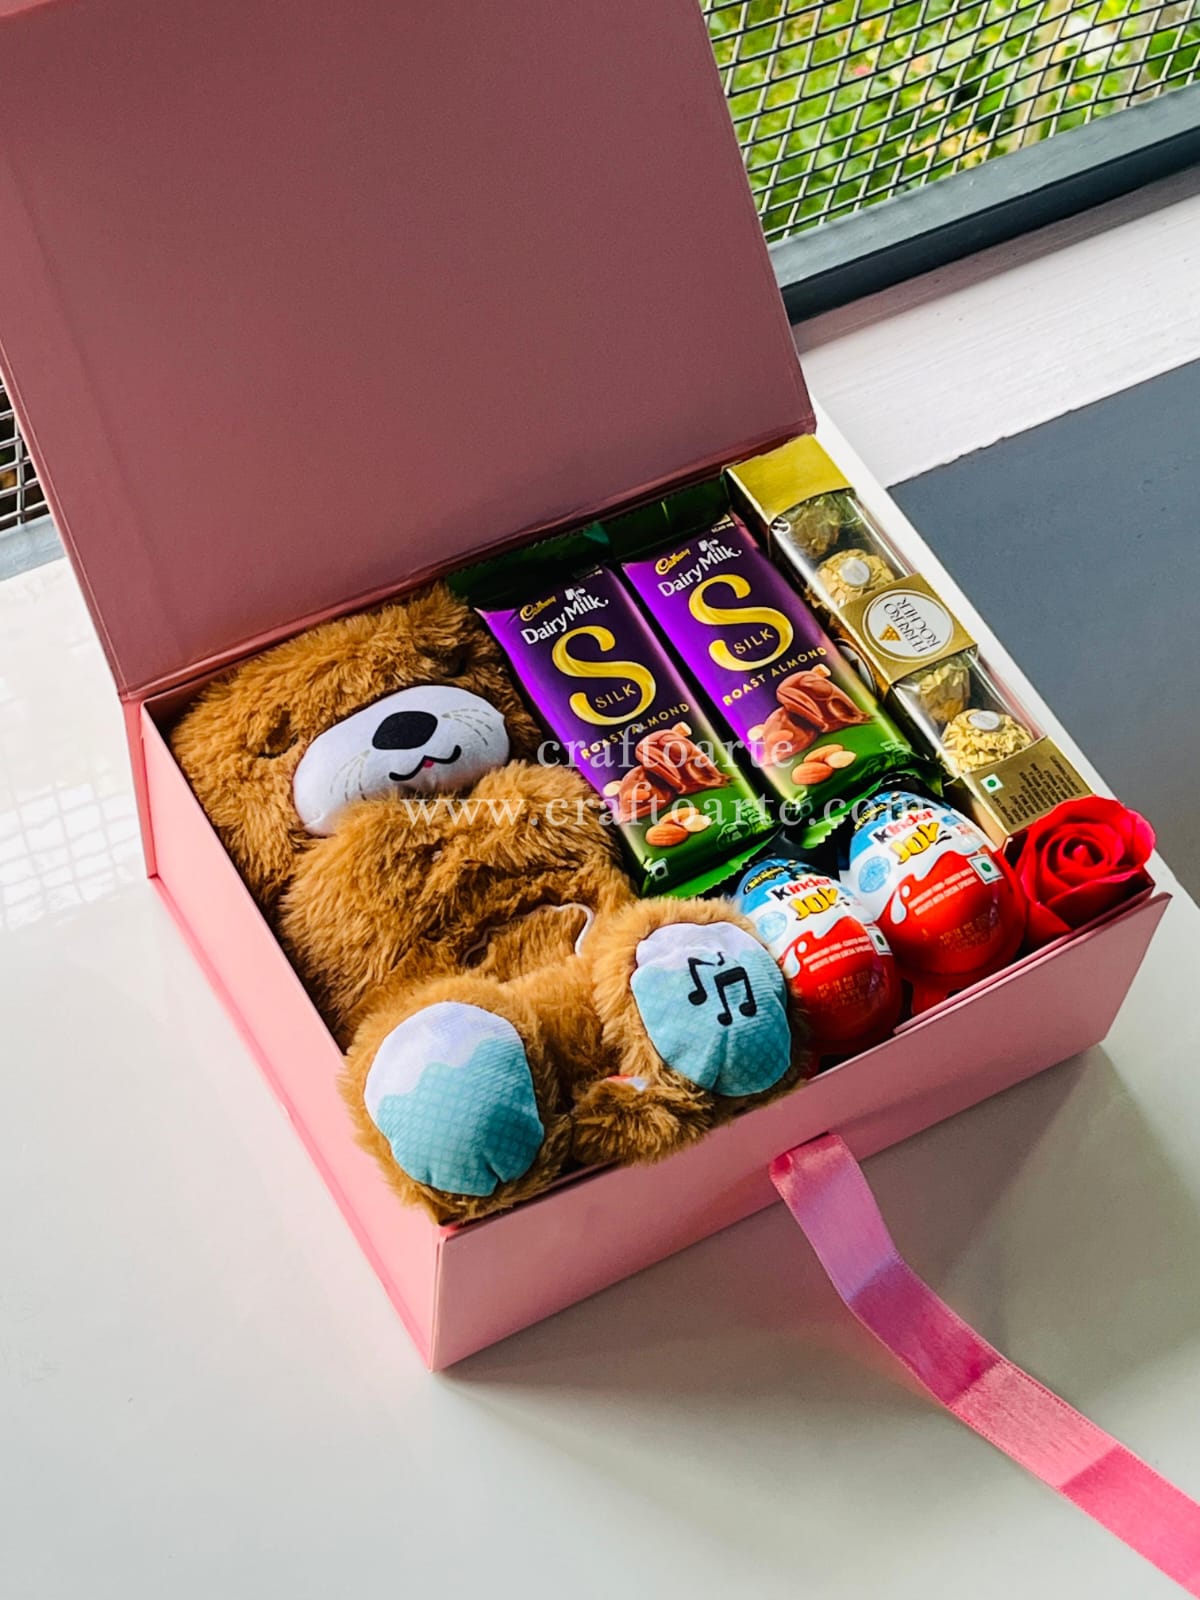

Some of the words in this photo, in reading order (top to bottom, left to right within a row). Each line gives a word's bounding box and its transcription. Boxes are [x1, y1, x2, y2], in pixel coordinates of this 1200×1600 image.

[657, 564, 703, 597] Dairy
[698, 545, 742, 571] Milk
[520, 613, 567, 645] Dairy
[563, 594, 609, 621] Milk
[688, 573, 794, 671] S
[734, 628, 775, 655] SILK
[883, 603, 929, 653] FERRERO
[896, 596, 941, 648] ROCHER
[551, 625, 657, 726] S
[595, 683, 637, 709] SILK
[722, 674, 766, 707] ROAST
[770, 646, 828, 678] ALMOND
[580, 730, 627, 760] ROAST
[631, 703, 690, 735] ALMOND
